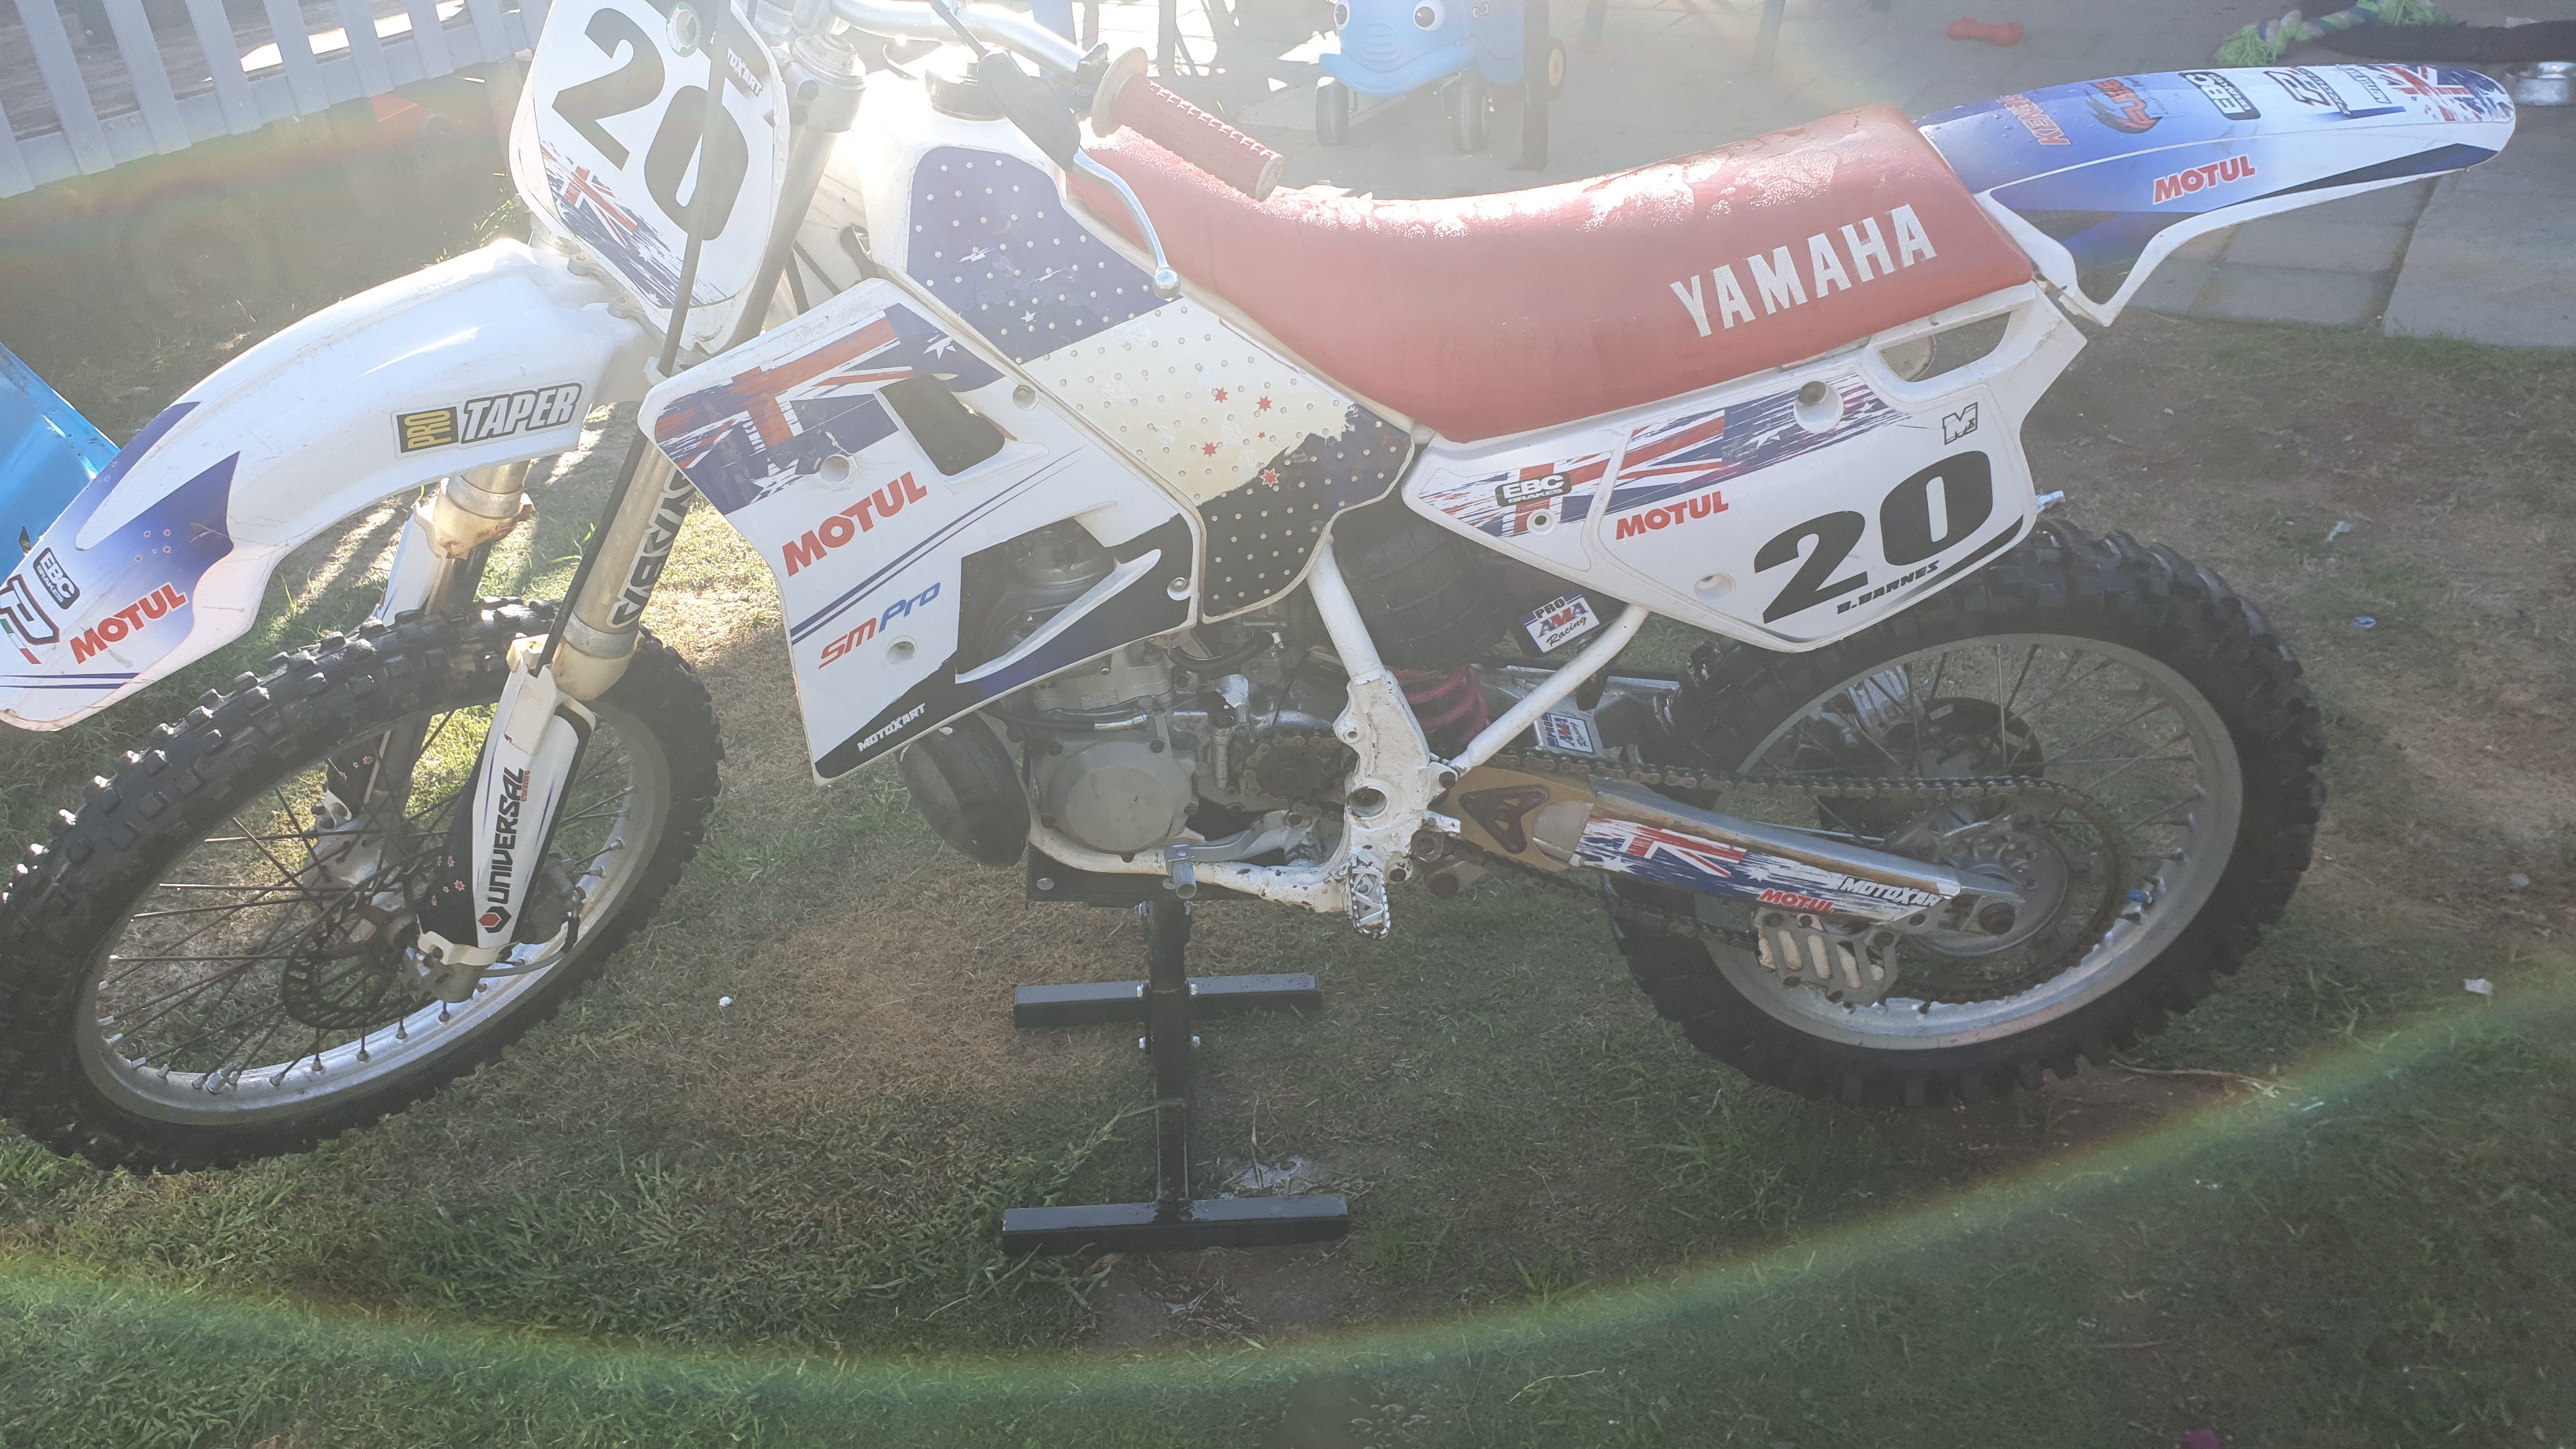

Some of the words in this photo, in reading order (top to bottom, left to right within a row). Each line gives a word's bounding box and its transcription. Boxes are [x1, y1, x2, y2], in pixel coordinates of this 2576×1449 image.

[2185, 73, 2245, 114] EBC
[551, 8, 749, 241] 20
[2154, 155, 2255, 203] MOTUL
[1669, 204, 1937, 337] YAMAHA
[404, 410, 451, 448] PRO
[463, 384, 581, 443] TAPER
[1502, 475, 1565, 498] EBC
[782, 471, 928, 577] MOTUL
[1616, 491, 1729, 540] MOTUL
[1754, 451, 1993, 624] 20
[36, 564, 64, 603] BRAKES
[40, 550, 75, 599] EBC
[69, 583, 187, 665] MOTUL
[1535, 598, 1565, 619] PRO
[1537, 601, 1590, 639] AMA
[1546, 617, 1588, 647] Racing
[857, 702, 926, 753] MOTOXART
[487, 767, 524, 905] UNIVERSAL
[1758, 889, 1835, 914] MOTUL
[1838, 876, 1942, 907] MOTOXAR
